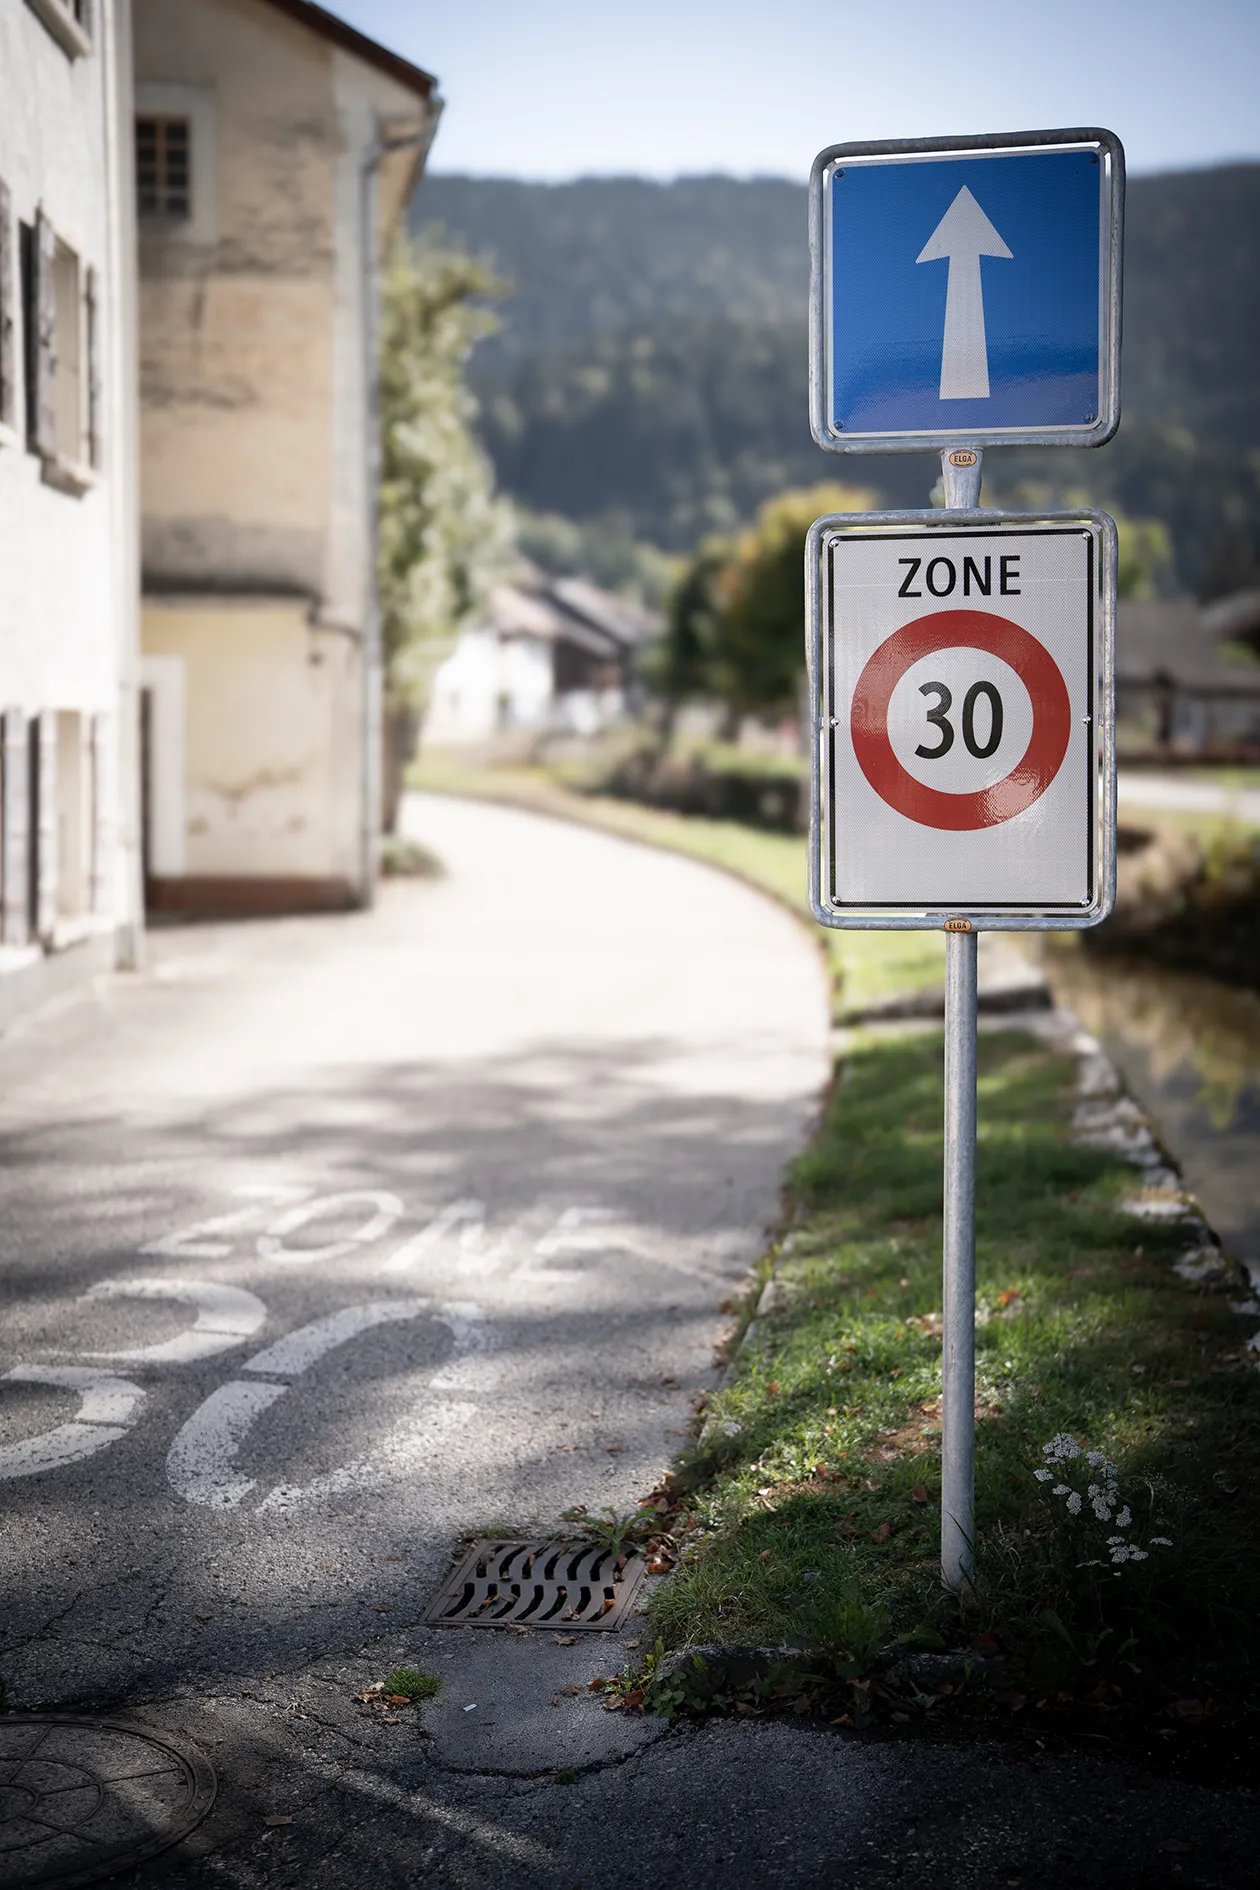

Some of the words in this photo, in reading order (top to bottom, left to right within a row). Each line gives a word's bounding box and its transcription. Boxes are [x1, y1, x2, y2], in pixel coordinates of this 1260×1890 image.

[953, 455, 973, 463] ELGA
[898, 555, 1021, 597] ZONE
[914, 680, 1004, 759] 30
[137, 1186, 634, 1283] ZONE
[0, 1279, 503, 1514] 30
